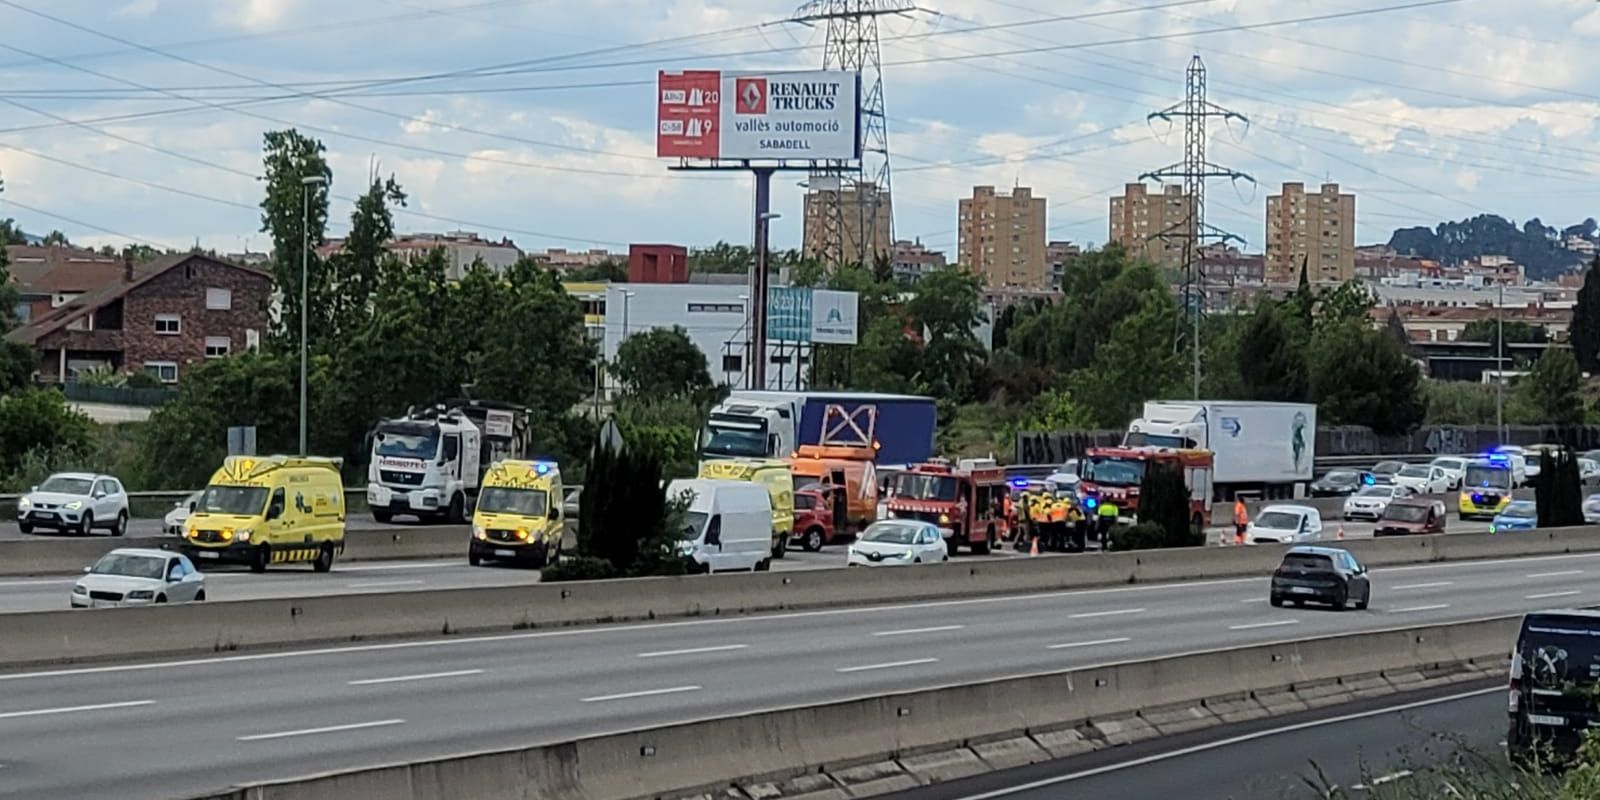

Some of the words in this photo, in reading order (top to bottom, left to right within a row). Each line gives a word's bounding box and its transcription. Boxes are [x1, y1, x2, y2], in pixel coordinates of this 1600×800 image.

[770, 83, 839, 96] RENAULT
[705, 91, 718, 104] 20
[773, 96, 835, 110] TRUCKS
[704, 121, 712, 134] 9
[736, 117, 770, 132] vallès
[775, 119, 839, 132] automoció
[760, 139, 811, 149] SABADELL
